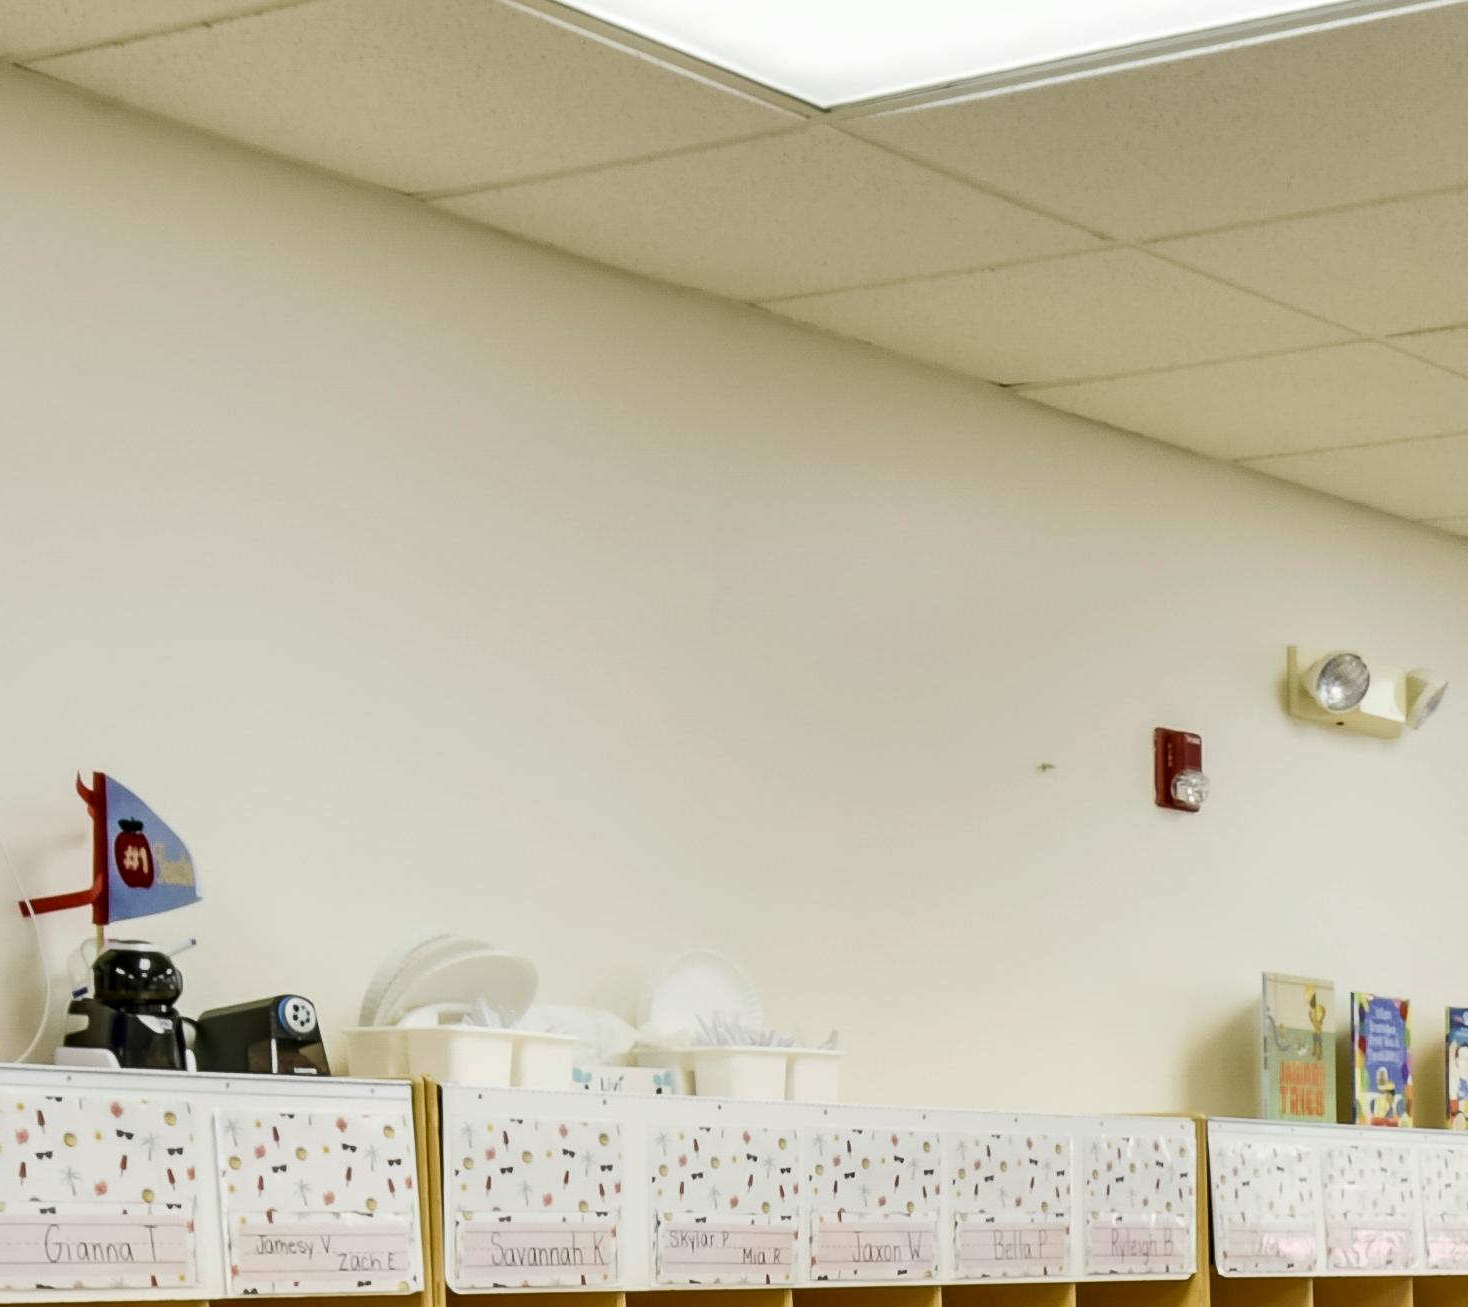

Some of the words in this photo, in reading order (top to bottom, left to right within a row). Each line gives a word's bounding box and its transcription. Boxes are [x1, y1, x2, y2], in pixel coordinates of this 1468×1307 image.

[44, 1223, 135, 1264] Gianna
[255, 1234, 314, 1261] Jamesy
[320, 1234, 332, 1254] V
[490, 1231, 583, 1267] Savannah
[593, 1232, 605, 1266] K
[669, 1230, 715, 1253] Skylar
[722, 1231, 731, 1249] P
[852, 1231, 902, 1264] Jaxon
[907, 1231, 924, 1261] W
[1039, 1229, 1048, 1259] P
[337, 1252, 382, 1272] Zach
[387, 1252, 397, 1271] E
[742, 1248, 766, 1265] Mia
[773, 1248, 782, 1265] R
